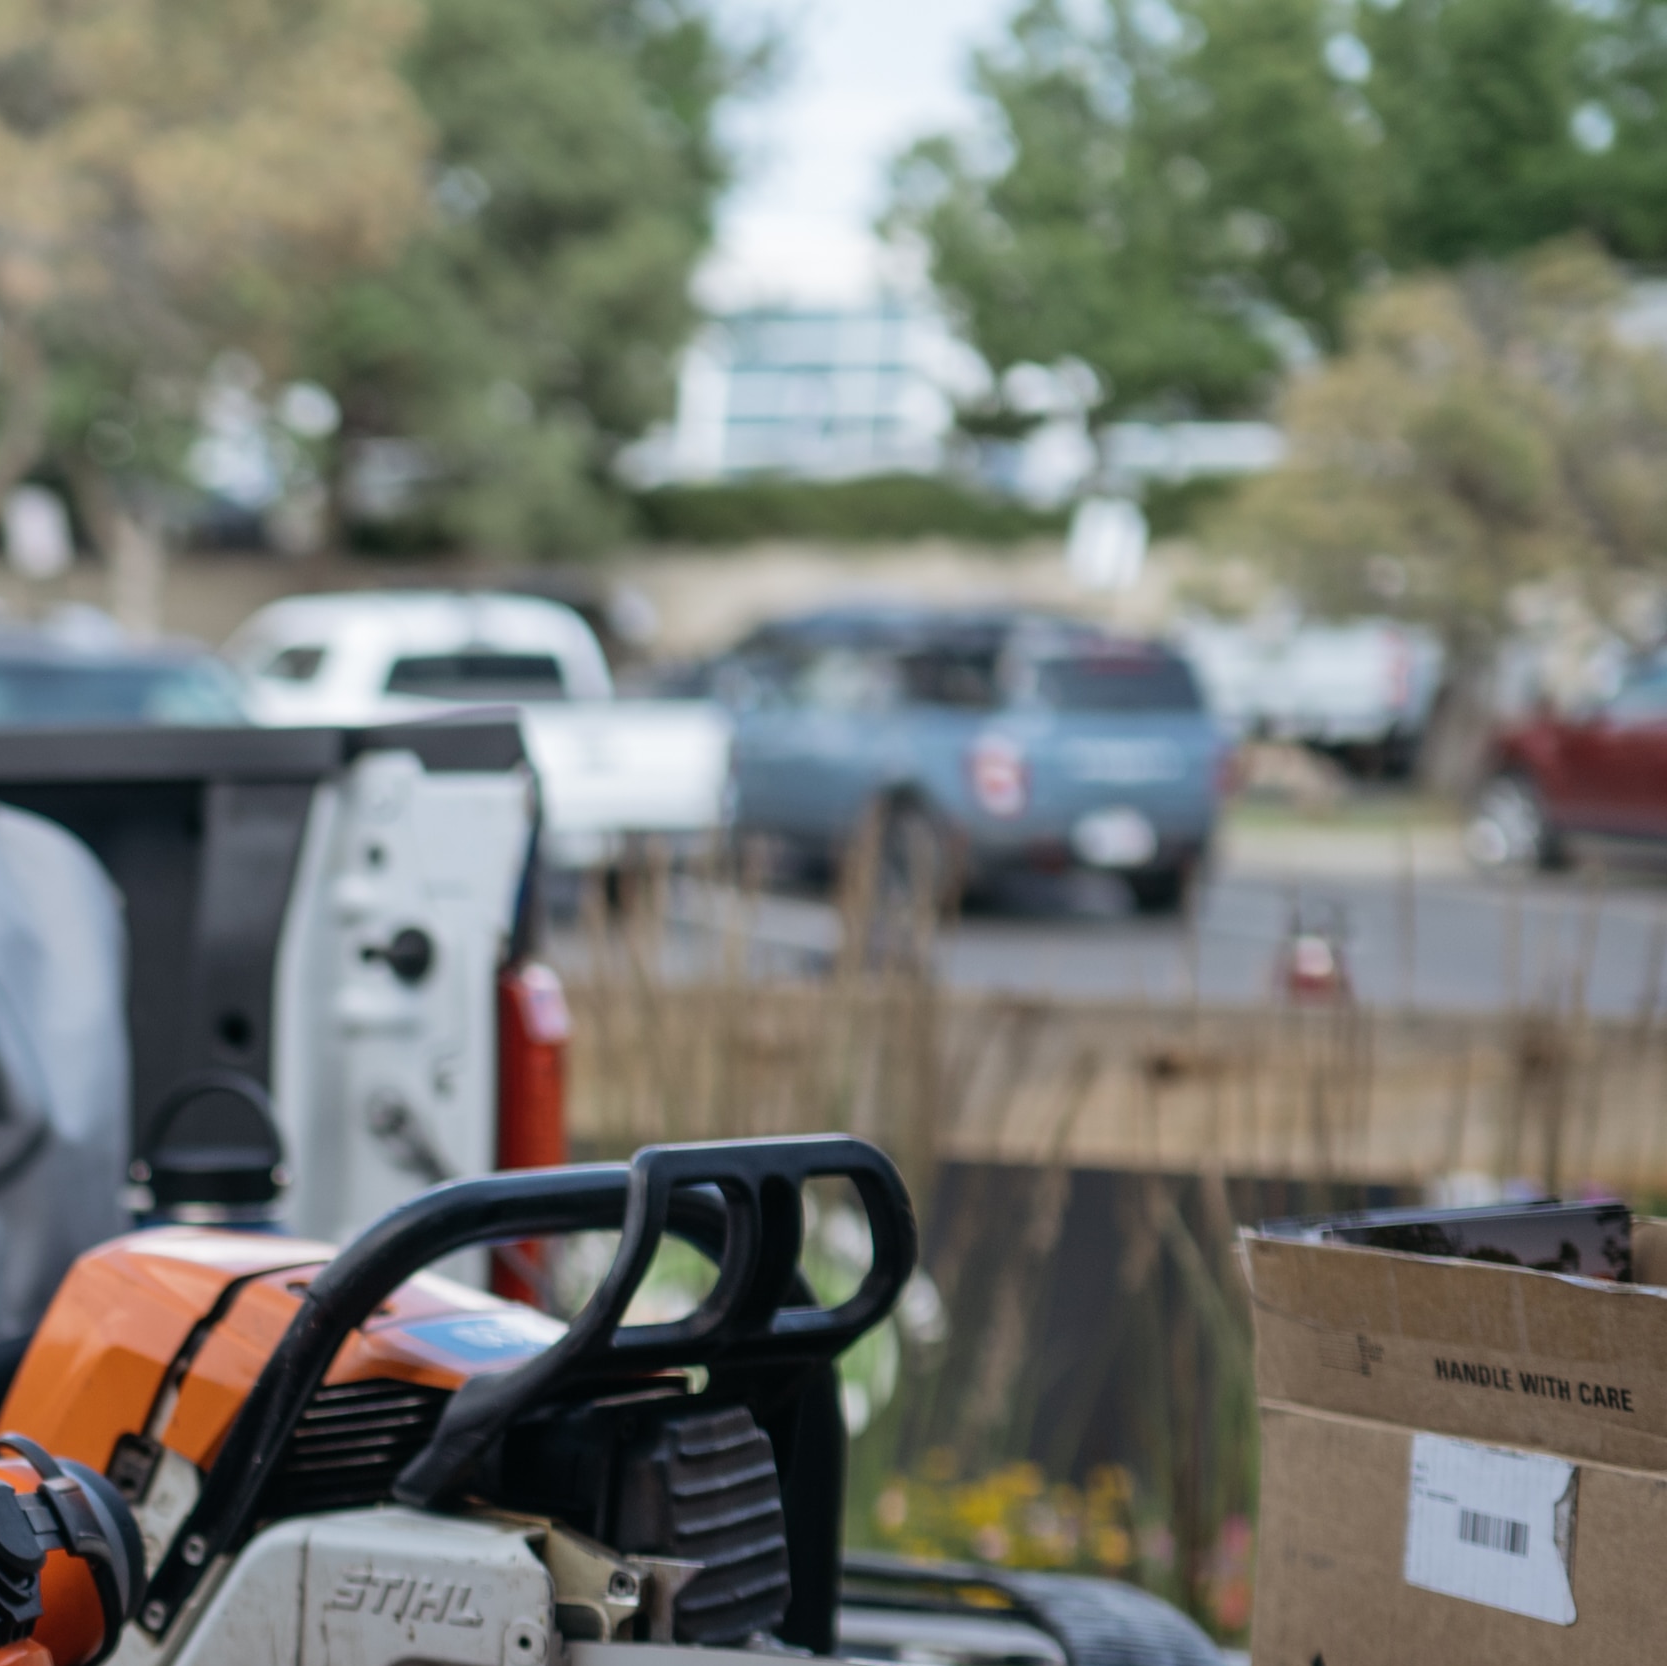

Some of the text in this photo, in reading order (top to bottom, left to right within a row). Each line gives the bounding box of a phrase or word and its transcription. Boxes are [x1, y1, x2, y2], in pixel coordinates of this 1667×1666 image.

[1434, 1357, 1634, 1413] HANDLE WITH CARE
[328, 1572, 485, 1629] STIHL
